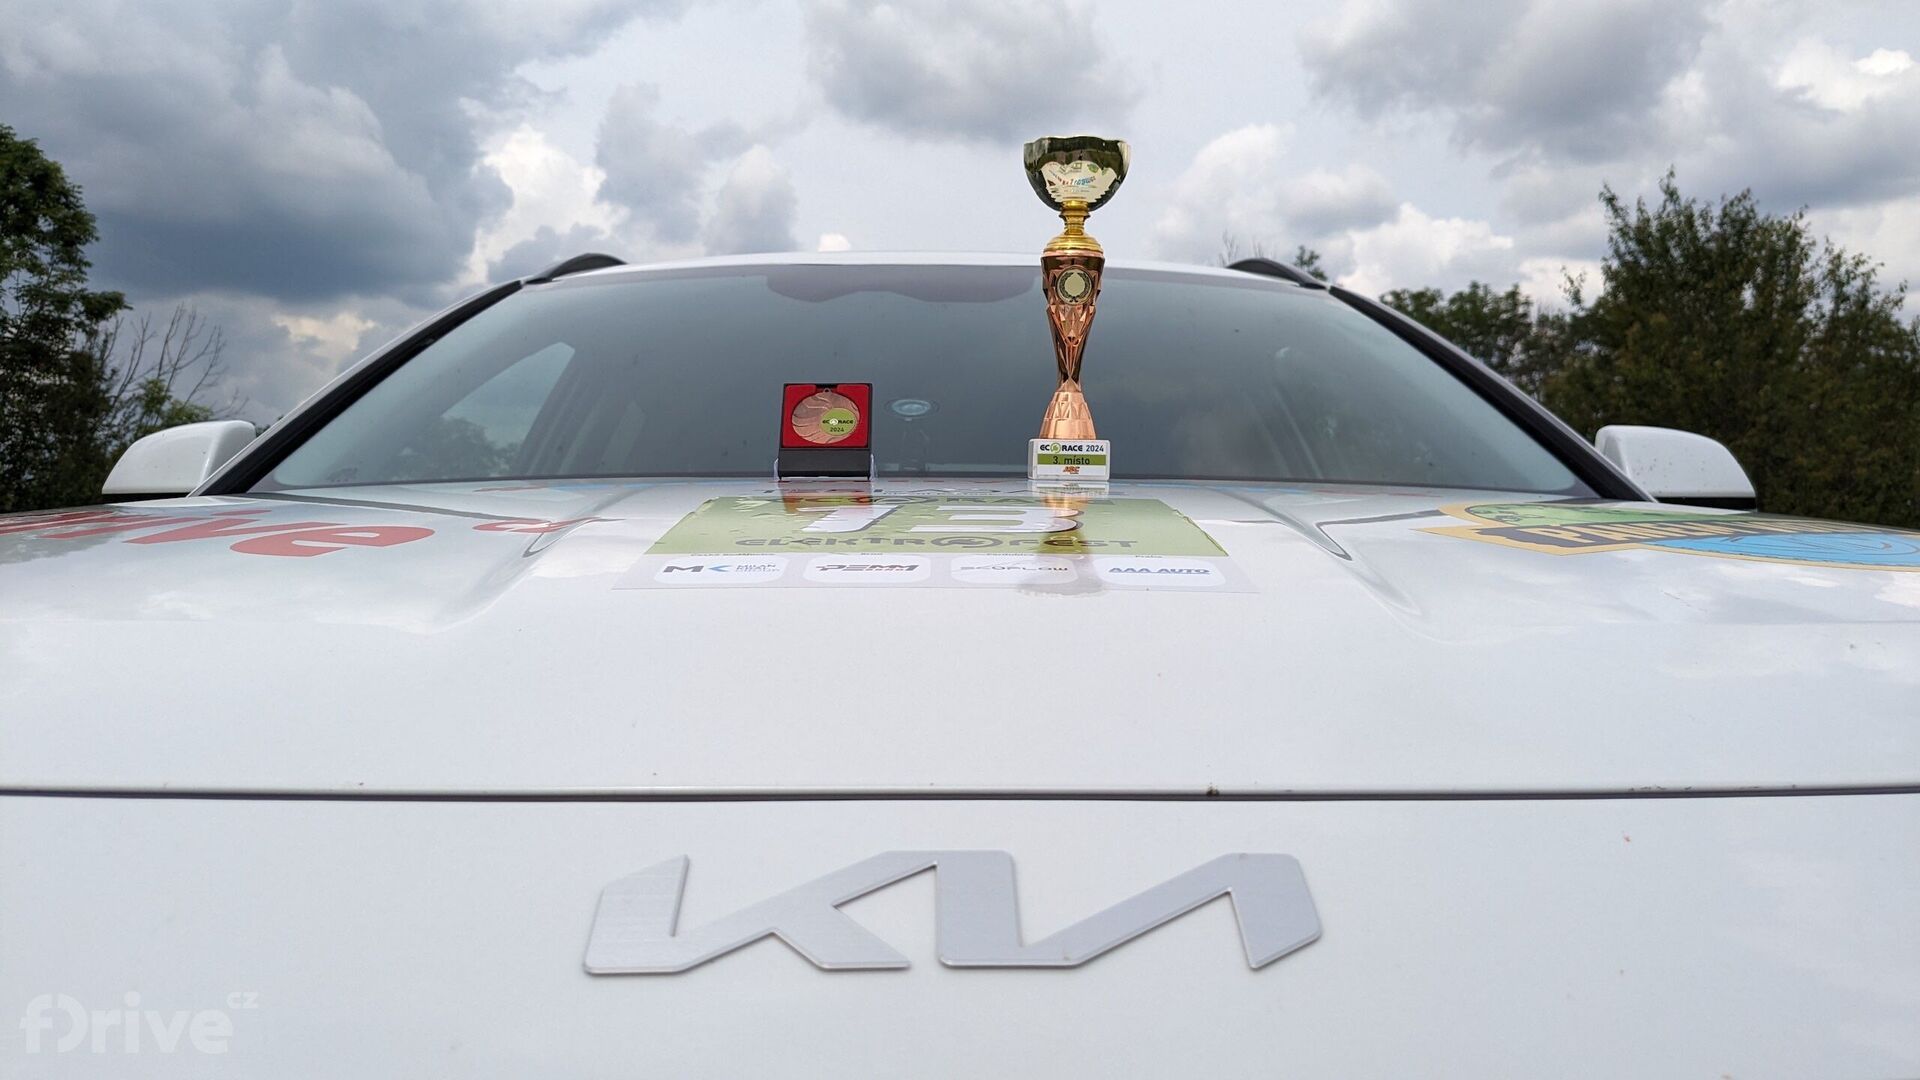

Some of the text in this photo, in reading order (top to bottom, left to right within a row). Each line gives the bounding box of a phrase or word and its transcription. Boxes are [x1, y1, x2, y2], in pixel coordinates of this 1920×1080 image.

[1053, 455, 1090, 465] 3. místo
[1516, 521, 1759, 543] PANEM
